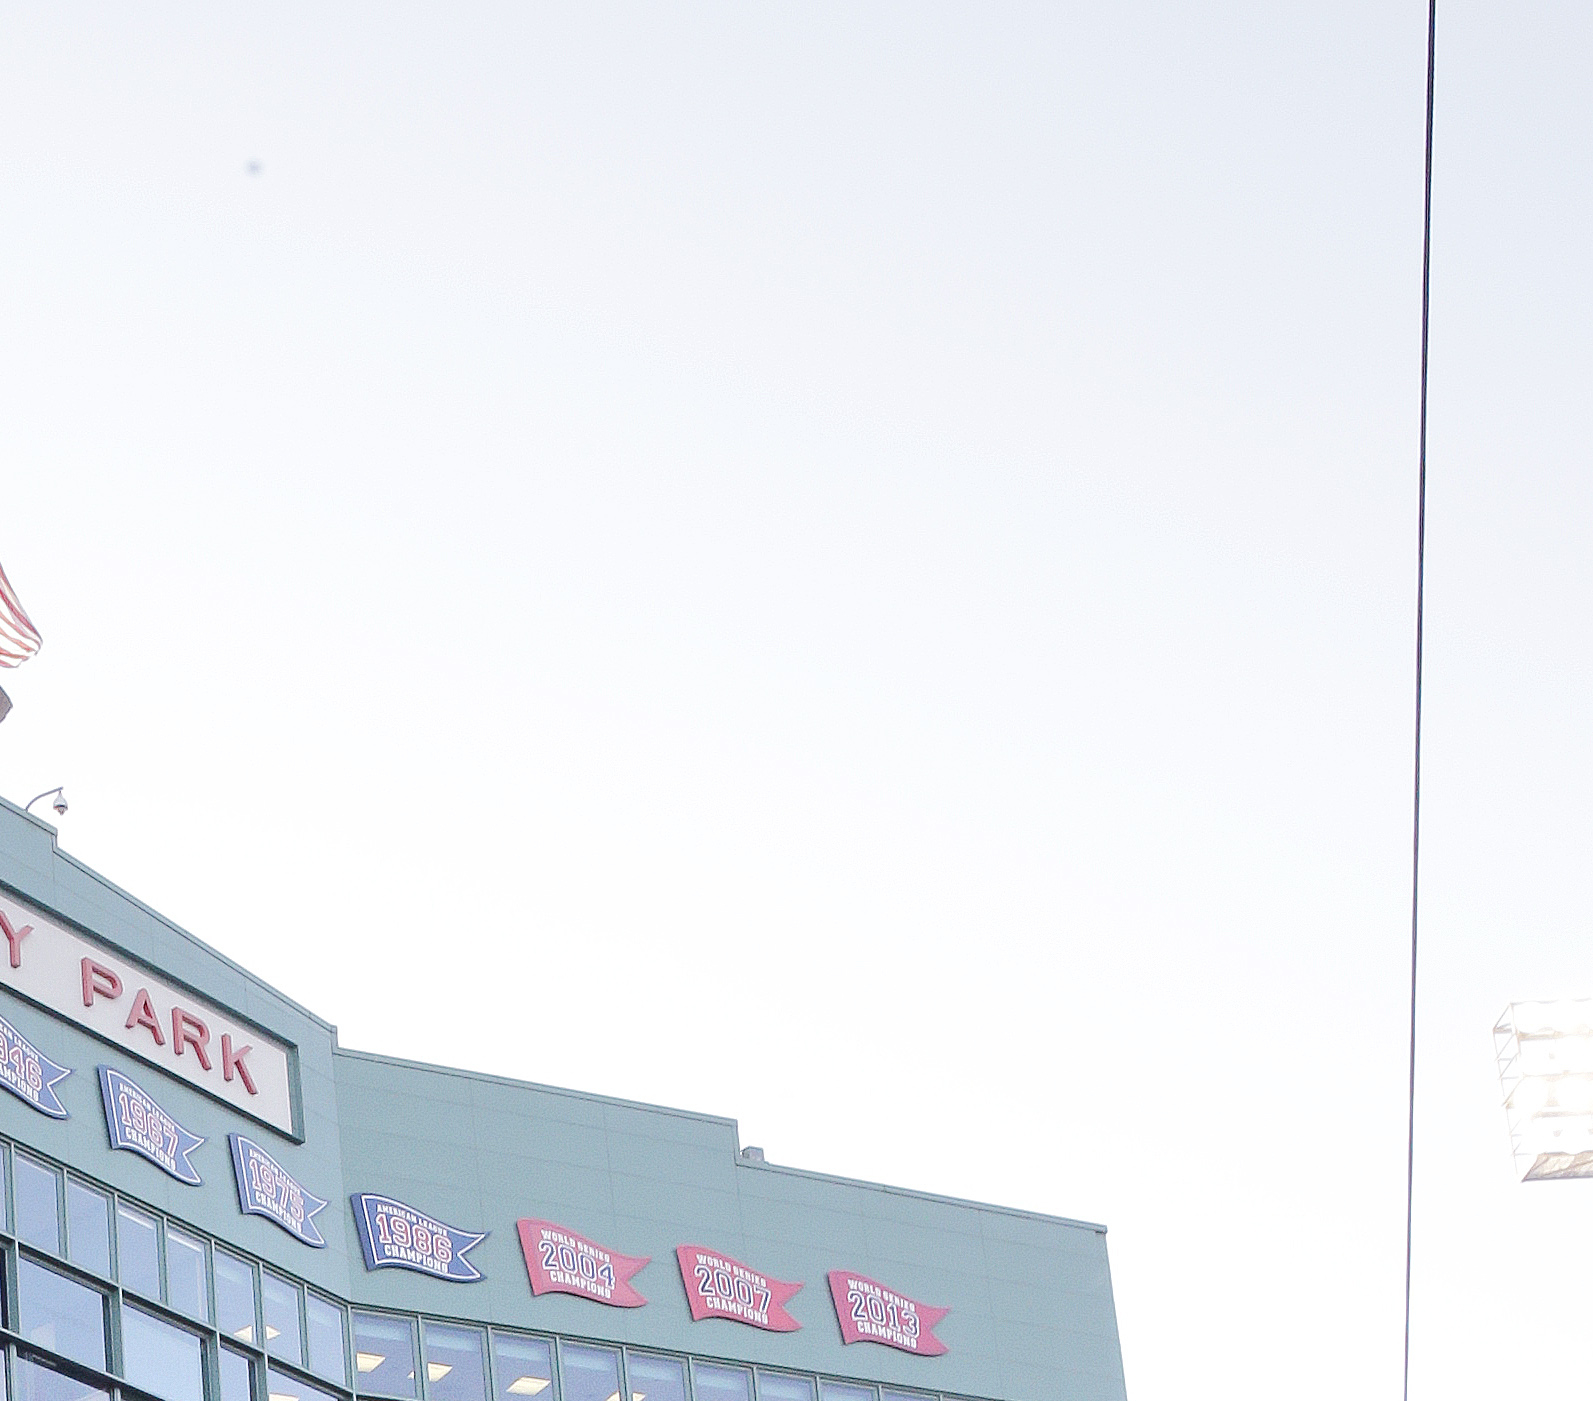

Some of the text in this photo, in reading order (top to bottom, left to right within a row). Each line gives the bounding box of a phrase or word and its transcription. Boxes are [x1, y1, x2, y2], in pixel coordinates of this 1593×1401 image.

[80, 956, 259, 1096] PARK
[119, 1092, 178, 1158] 1967
[125, 1126, 176, 1171] CHAMPIONS
[249, 1159, 304, 1222] 1975
[256, 1190, 302, 1233] CHAMPIONS
[377, 1204, 417, 1224] AMERICAN
[375, 1213, 452, 1263] 1986
[384, 1245, 448, 1273] CHAMPIONS
[541, 1229, 610, 1263] WORLD SERIES
[538, 1240, 615, 1290] 2004
[549, 1270, 611, 1299] CHAMPIONS
[696, 1254, 766, 1287] WORLD SERIES
[694, 1264, 771, 1314] 2007
[847, 1279, 915, 1313] WORLD SERIES
[706, 1297, 768, 1325] CHAMPIONS
[847, 1290, 919, 1338] 2013
[857, 1321, 917, 1349] CHAMPIONS
